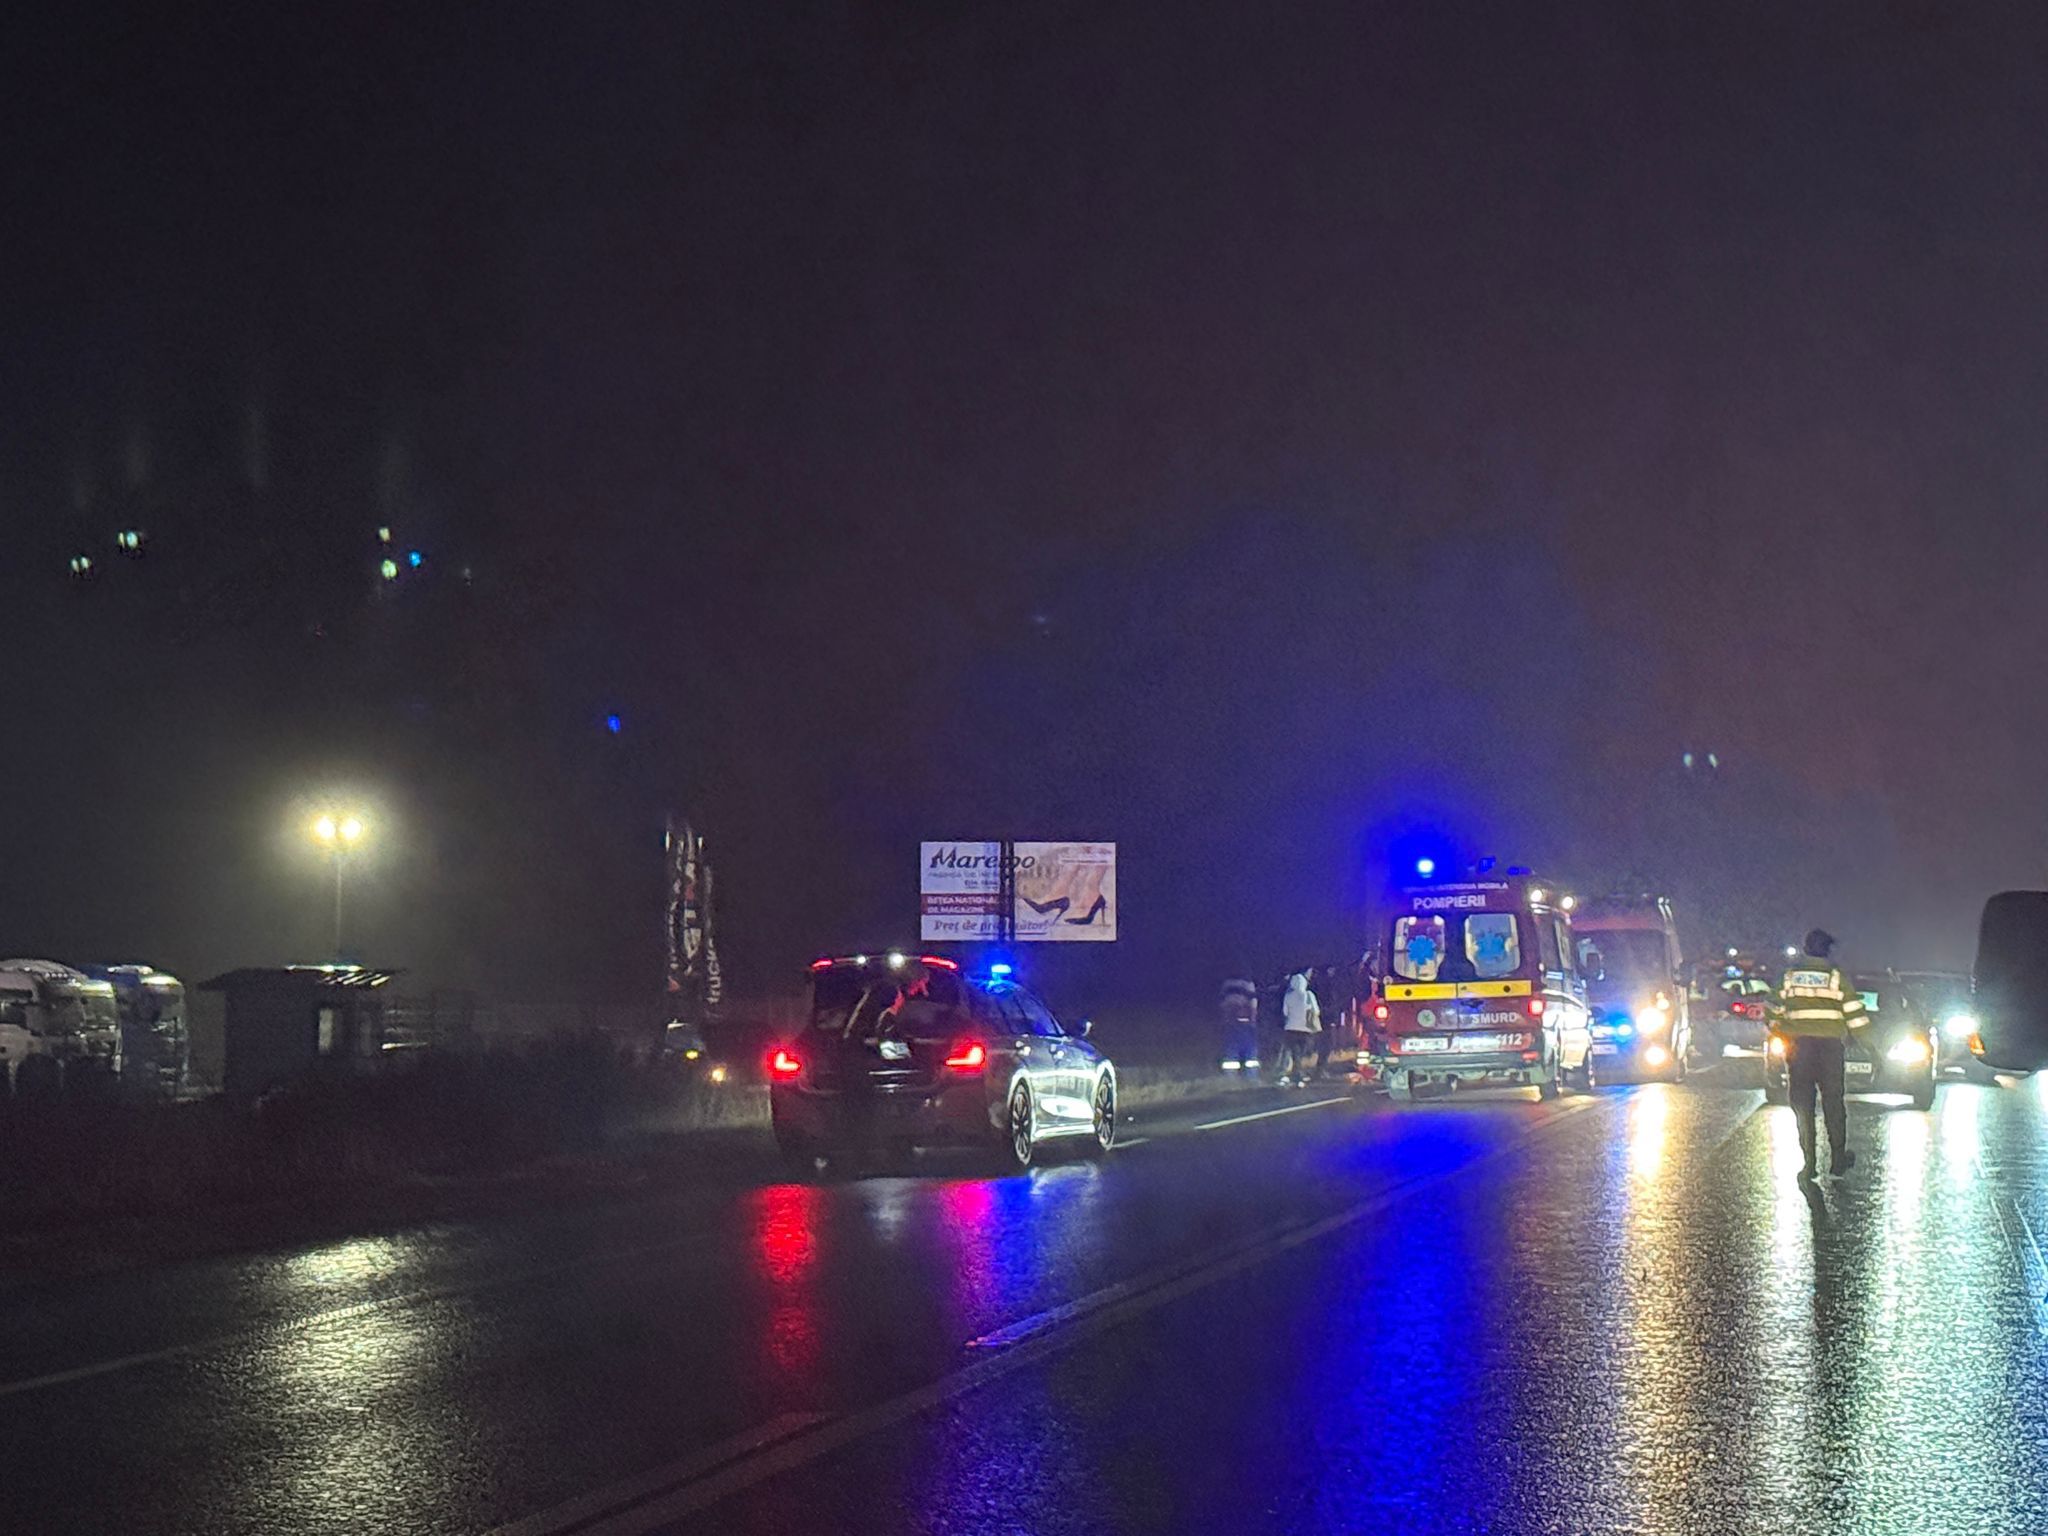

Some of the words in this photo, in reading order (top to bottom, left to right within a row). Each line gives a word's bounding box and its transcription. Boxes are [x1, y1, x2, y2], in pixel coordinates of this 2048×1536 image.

[930, 846, 1036, 869] Marebo
[1413, 894, 1486, 910] POMPIERII
[1472, 1012, 1517, 1024] SMURD
[1501, 1034, 1522, 1046] 112
